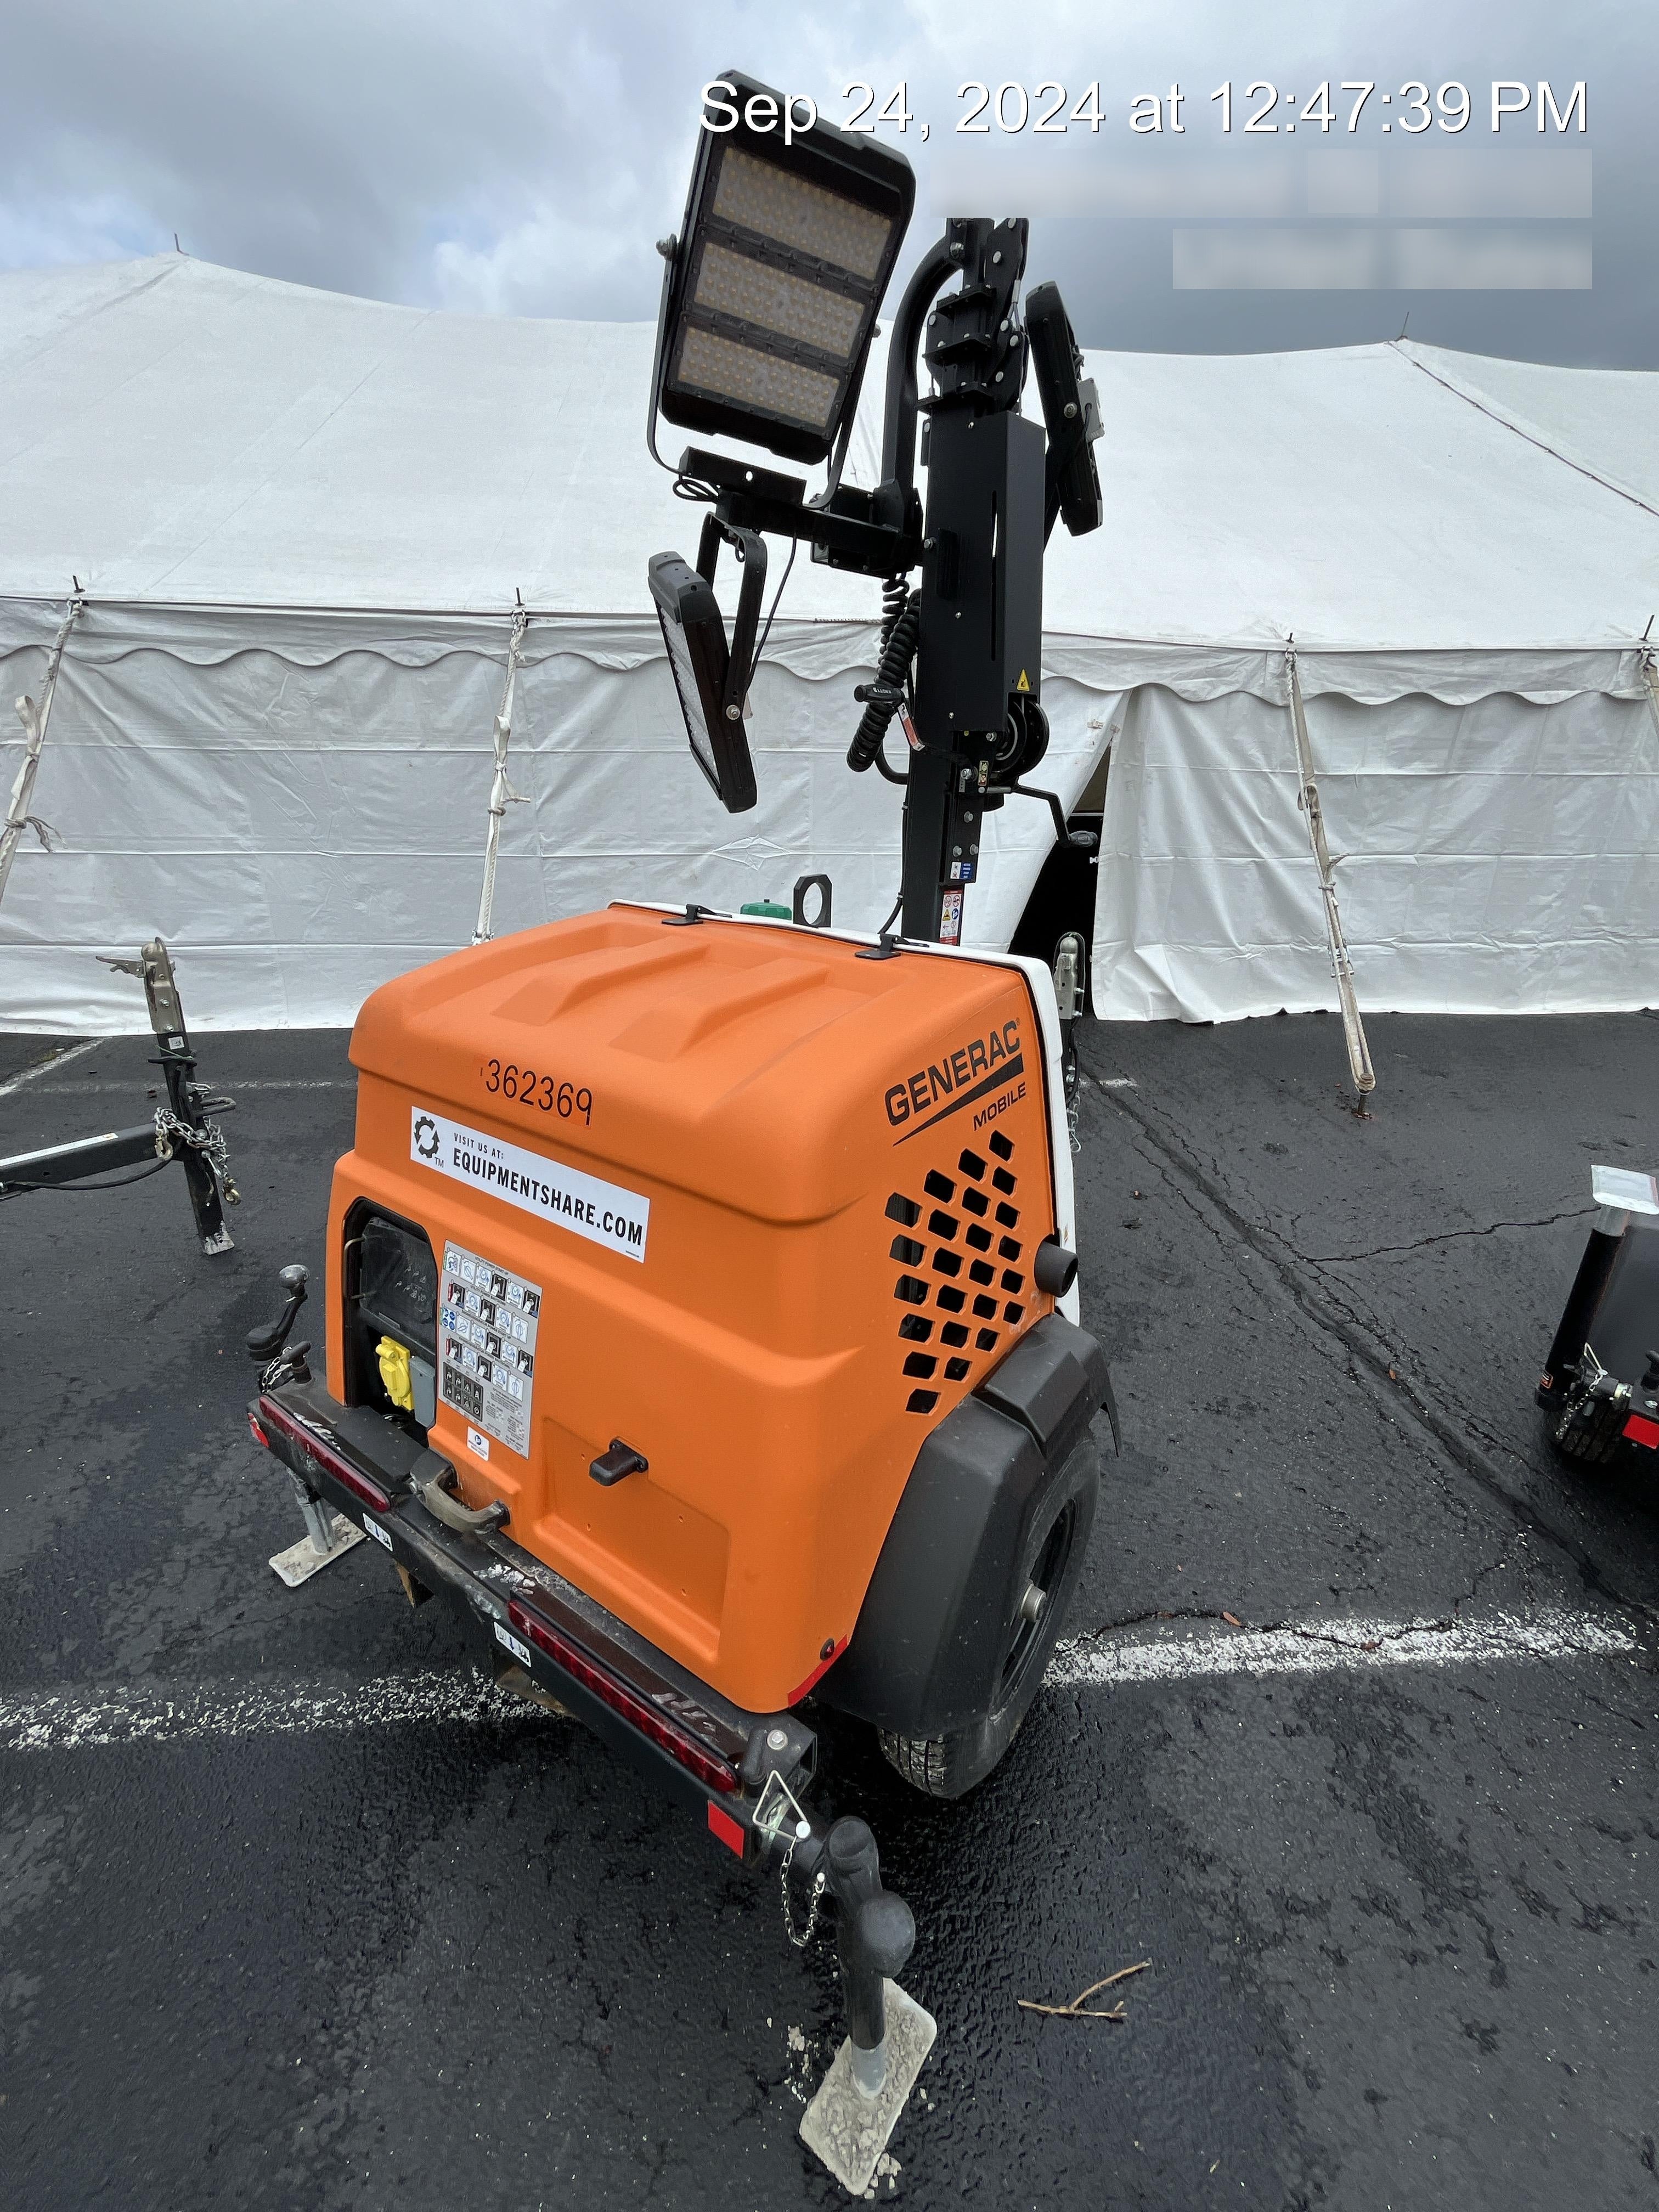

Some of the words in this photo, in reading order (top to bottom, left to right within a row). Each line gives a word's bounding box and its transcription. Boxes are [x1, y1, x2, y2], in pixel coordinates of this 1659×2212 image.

[486, 1059, 593, 1126] 362369
[884, 1020, 1020, 1126] GENERAC
[973, 1082, 1026, 1131] MOBILE
[435, 1156, 444, 1169] TM
[454, 1132, 475, 1149] VISIT
[478, 1142, 488, 1154] US
[492, 1148, 504, 1160] AT:
[453, 1147, 643, 1246] EQUIPMENTSHARE.COM
